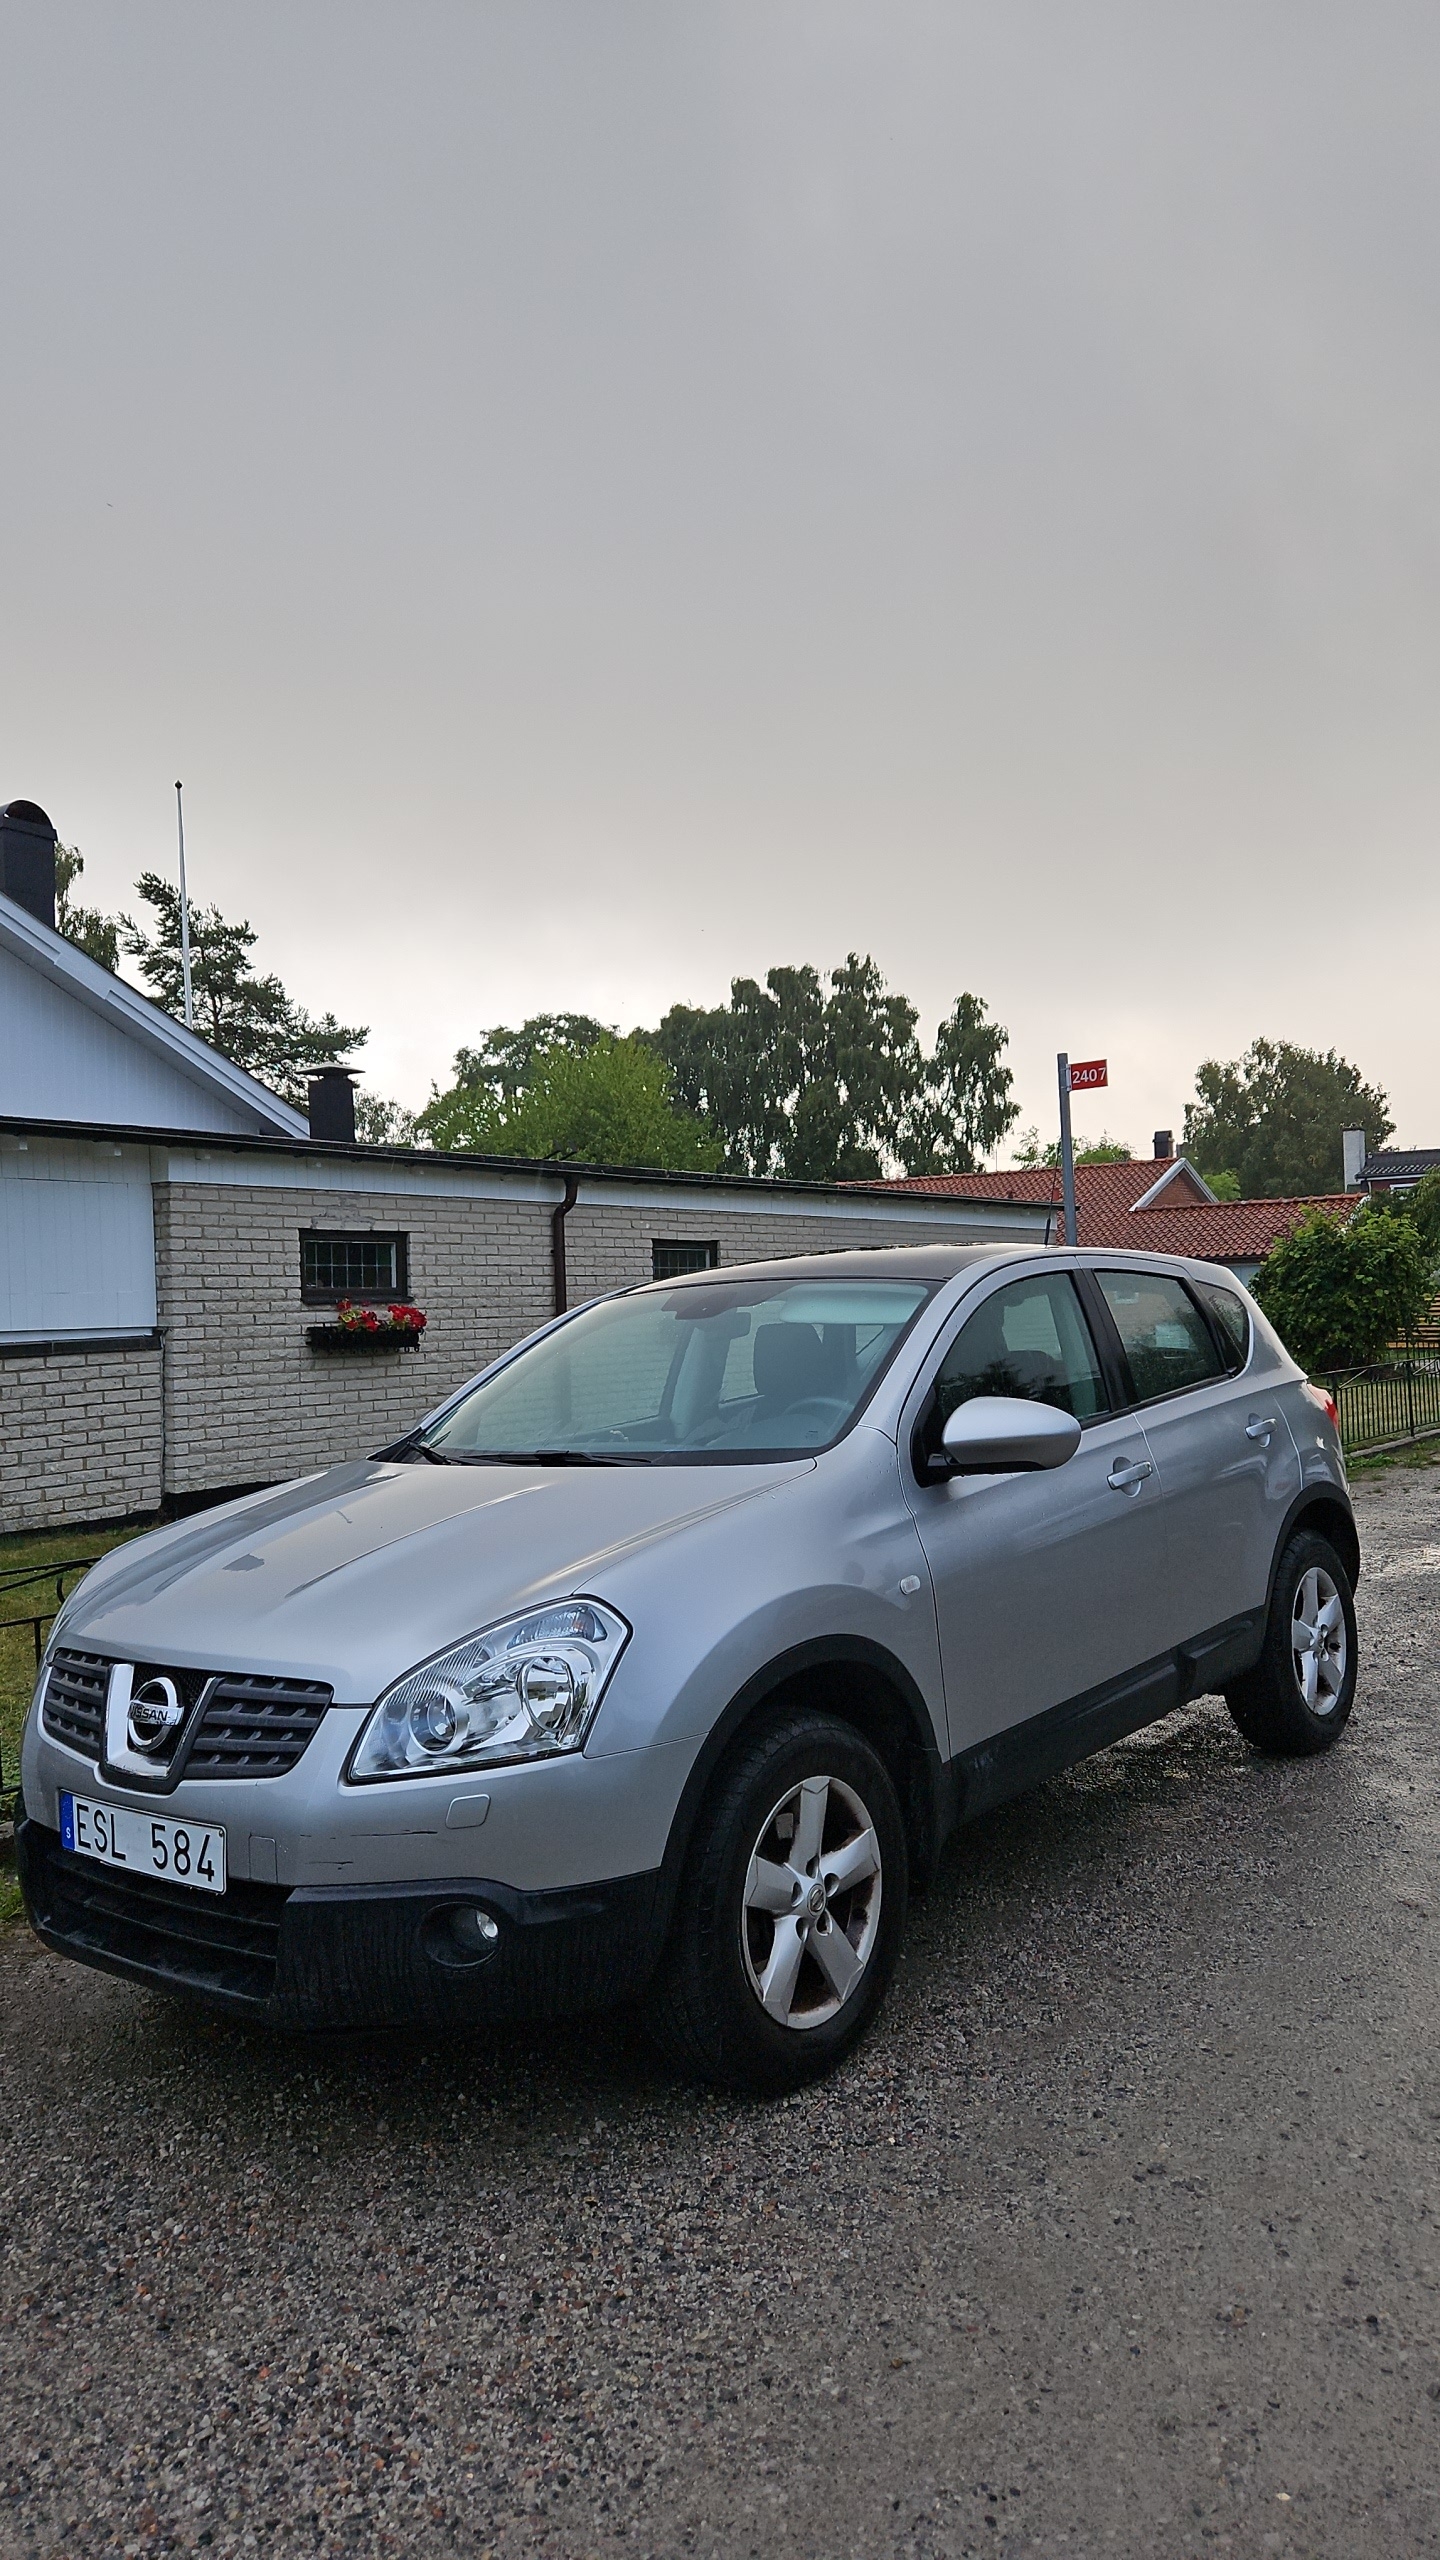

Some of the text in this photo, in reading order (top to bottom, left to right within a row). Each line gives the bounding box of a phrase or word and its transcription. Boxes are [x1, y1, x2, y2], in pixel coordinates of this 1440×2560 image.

[1072, 1067, 1106, 1084] 2407
[65, 1827, 71, 1839] S
[76, 1803, 215, 1882] ESL 584
